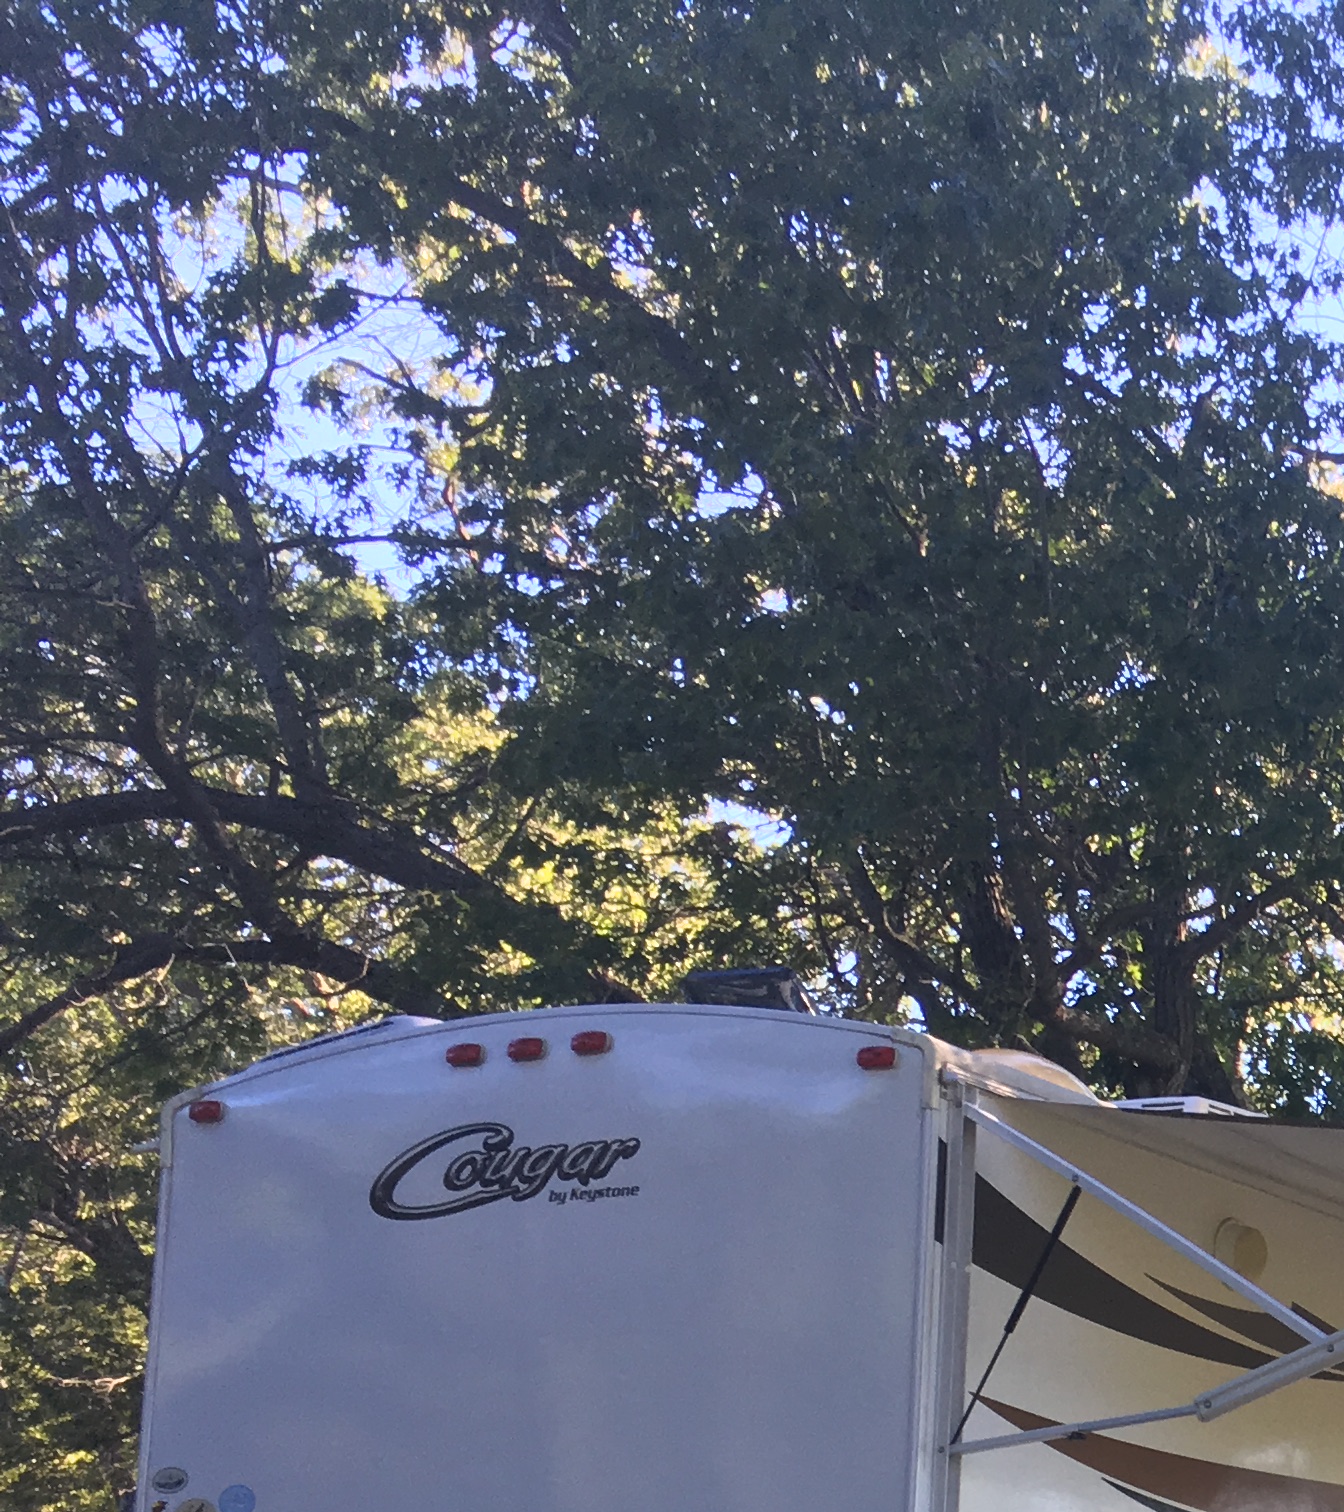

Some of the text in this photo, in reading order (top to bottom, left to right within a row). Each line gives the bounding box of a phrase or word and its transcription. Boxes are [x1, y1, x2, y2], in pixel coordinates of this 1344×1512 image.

[369, 1122, 641, 1221] Cougar
[549, 1186, 640, 1205] by Keystone
